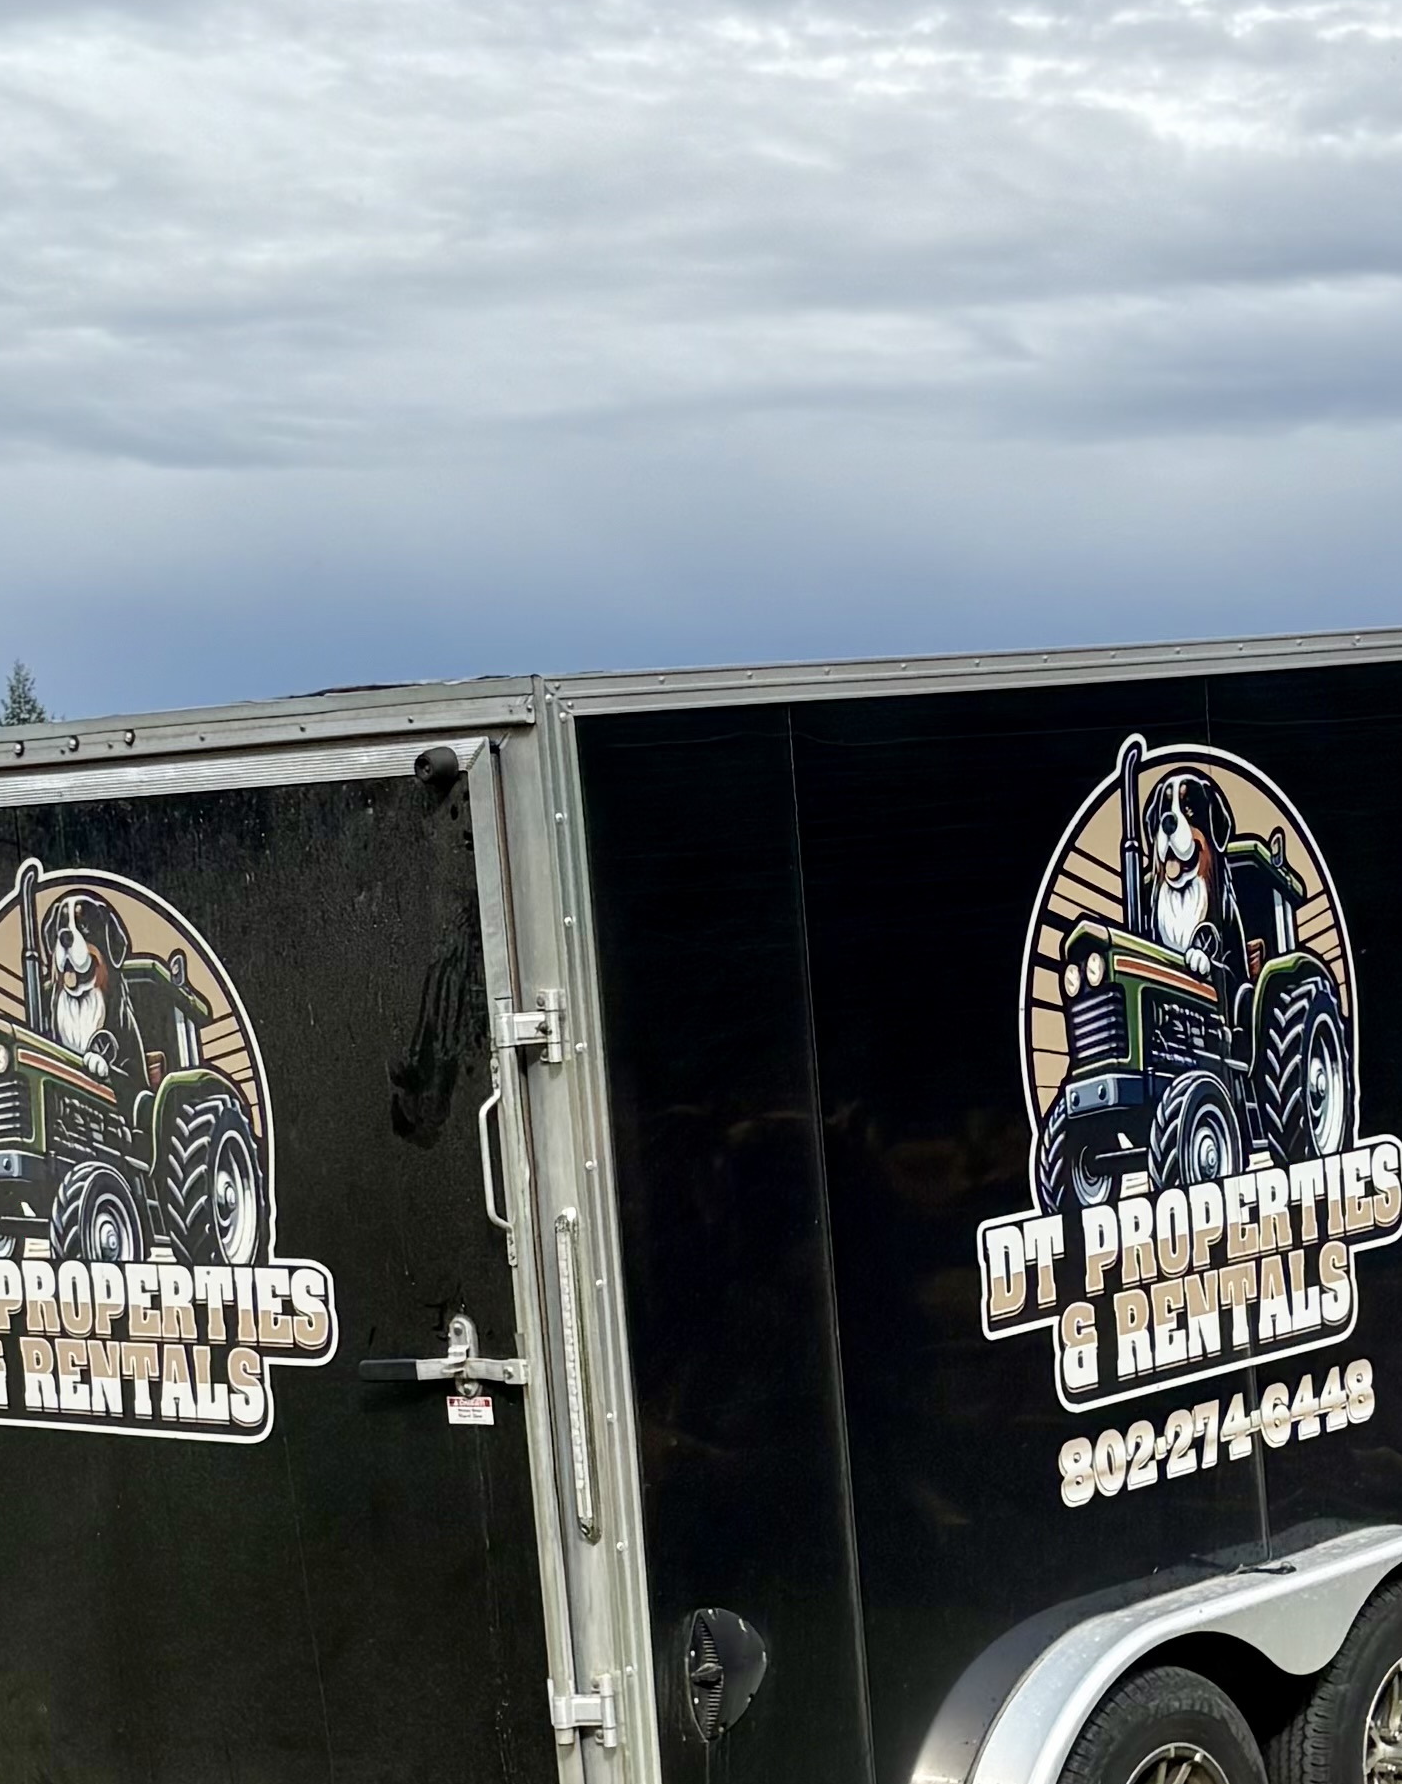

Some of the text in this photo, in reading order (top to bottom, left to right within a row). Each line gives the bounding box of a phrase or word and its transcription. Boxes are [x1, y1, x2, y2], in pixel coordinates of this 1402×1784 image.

[985, 1143, 1402, 1321] DT PROPERTIES
[19, 1335, 265, 1427] RENTALS
[1061, 1240, 1352, 1393] & RENTALS
[1058, 1358, 1376, 1508] 802-274-6448
